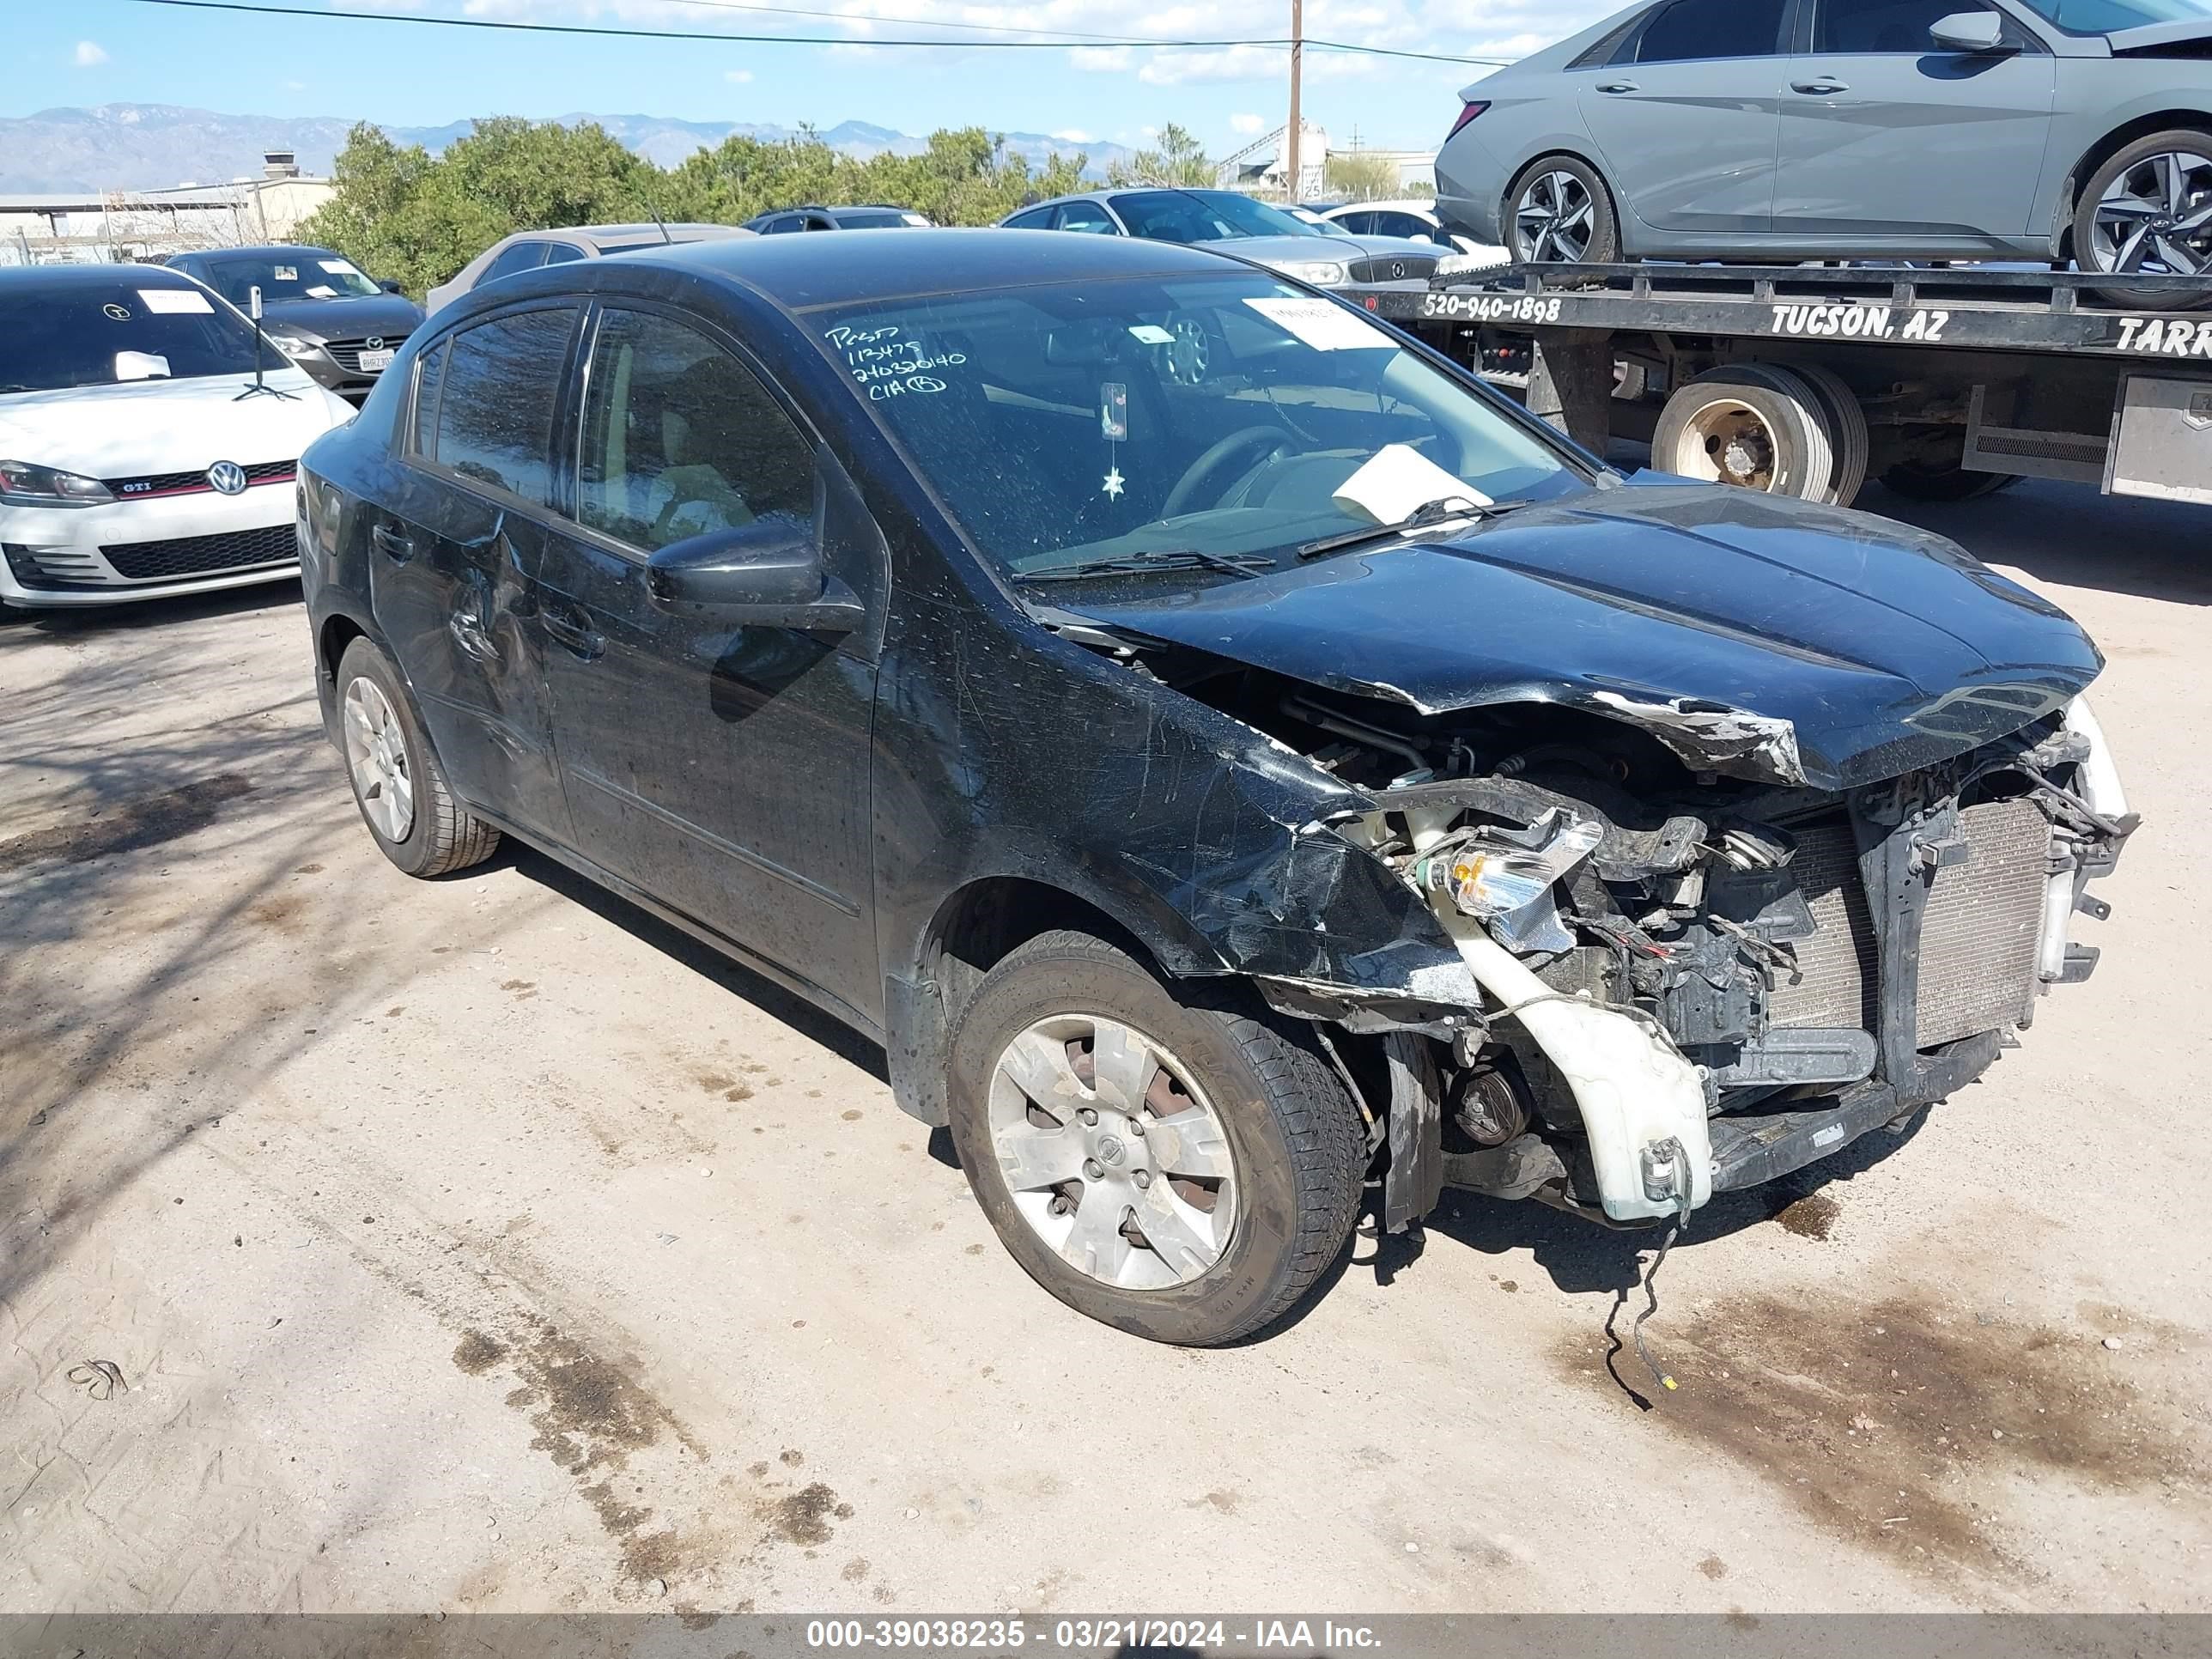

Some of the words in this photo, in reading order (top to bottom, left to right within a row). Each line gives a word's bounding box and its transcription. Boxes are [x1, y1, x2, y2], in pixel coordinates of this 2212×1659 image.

[1424, 294, 1561, 324] 520-940-1898
[1771, 305, 1895, 339] TUCSON,
[1902, 309, 1949, 341] AZ
[2117, 318, 2212, 359] TARR
[123, 482, 152, 493] GTI
